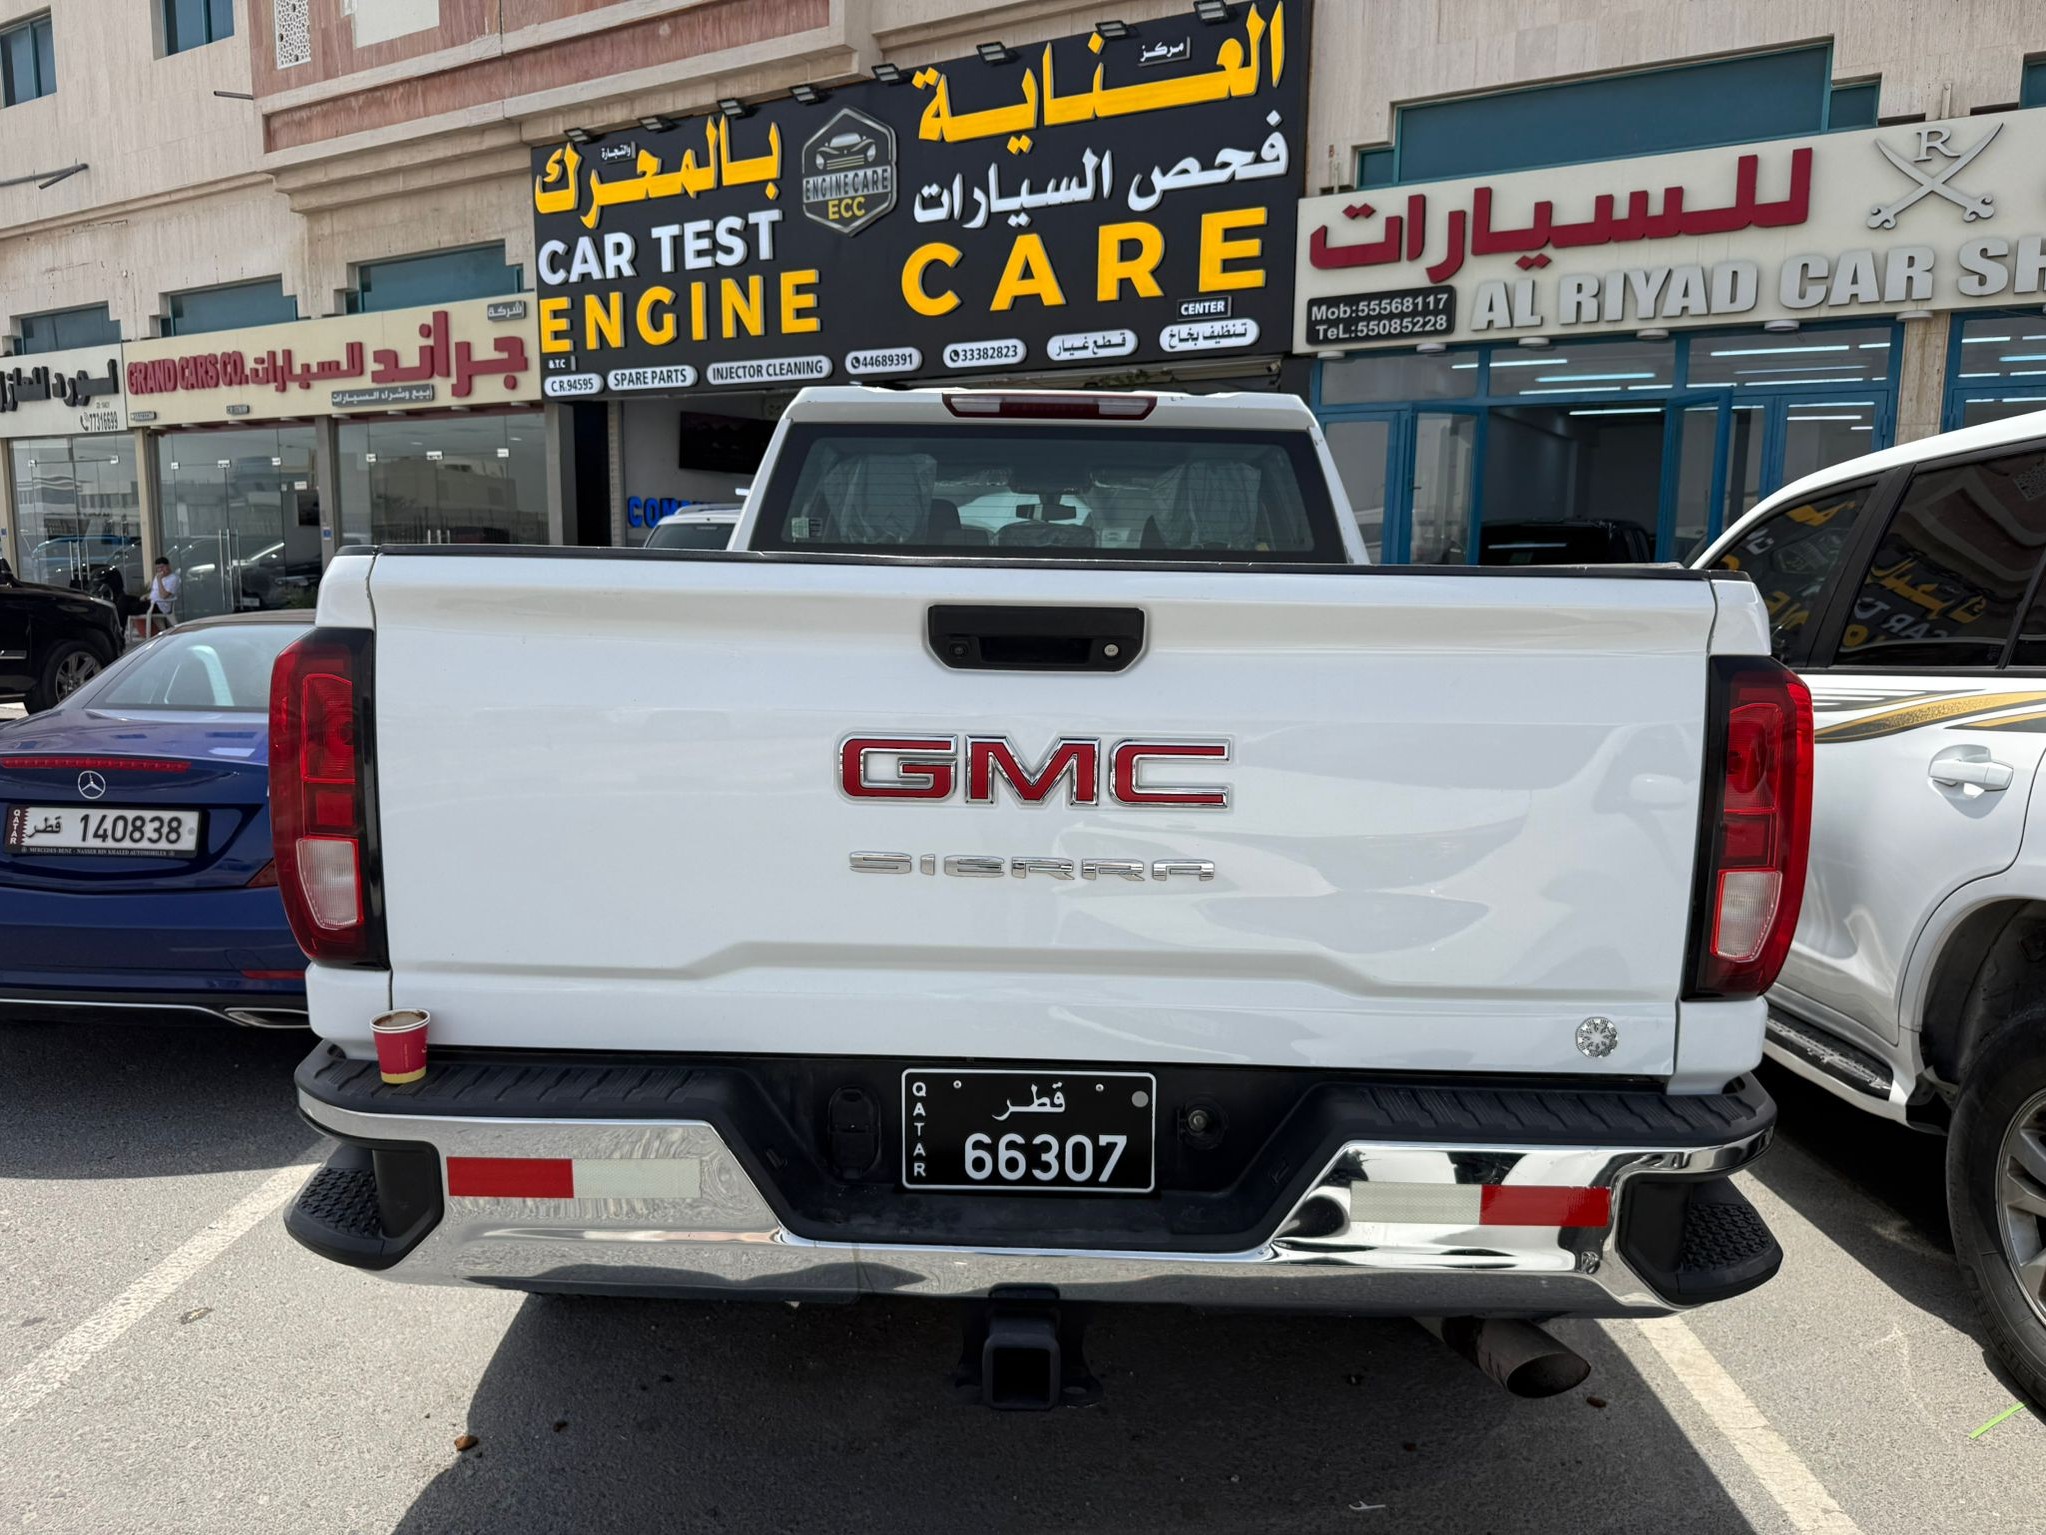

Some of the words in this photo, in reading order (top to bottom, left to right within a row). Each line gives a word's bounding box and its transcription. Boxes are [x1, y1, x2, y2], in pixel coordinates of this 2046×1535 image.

[1140, 40, 1184, 63] مركز
[911, 1, 1284, 154] العناية
[1127, 110, 1289, 211] فحص
[1914, 127, 1960, 163] R
[535, 114, 781, 229] بالمحرك
[913, 147, 1113, 229] السيارات
[828, 196, 866, 220] ECC
[1309, 147, 1813, 284] للسيارات
[537, 232, 637, 285] CAR
[651, 209, 783, 272] TEST
[539, 269, 821, 353] ENGINE
[901, 206, 1268, 316] CARE
[1470, 279, 1543, 331] AL
[1558, 261, 1759, 326] RIYAD
[1778, 245, 1936, 309] CAR
[488, 302, 523, 319] شركة
[1180, 300, 1226, 316] CENTER
[1056, 337, 1091, 356] غيار
[1092, 332, 1127, 355] قطع
[1202, 322, 1248, 345] تنظيف
[371, 310, 528, 397] جراند
[713, 364, 764, 381] INJECTOR
[766, 360, 823, 377] CLEANING
[862, 353, 913, 369] 44689391
[961, 345, 1018, 362] 33382823
[127, 358, 178, 395] GRAND
[178, 353, 220, 390] CARS
[220, 351, 249, 386] CO.
[614, 371, 649, 387] SPARE
[651, 368, 687, 384] PARTS
[838, 733, 1232, 809] GMC
[9, 809, 21, 845] QATAR
[26, 815, 62, 838] قطر
[80, 813, 183, 844] 140838
[849, 850, 1215, 882] SIERRA
[992, 1081, 1066, 1121] قطر
[912, 1081, 927, 1177] QATAR
[964, 1132, 1128, 1183] 66307
